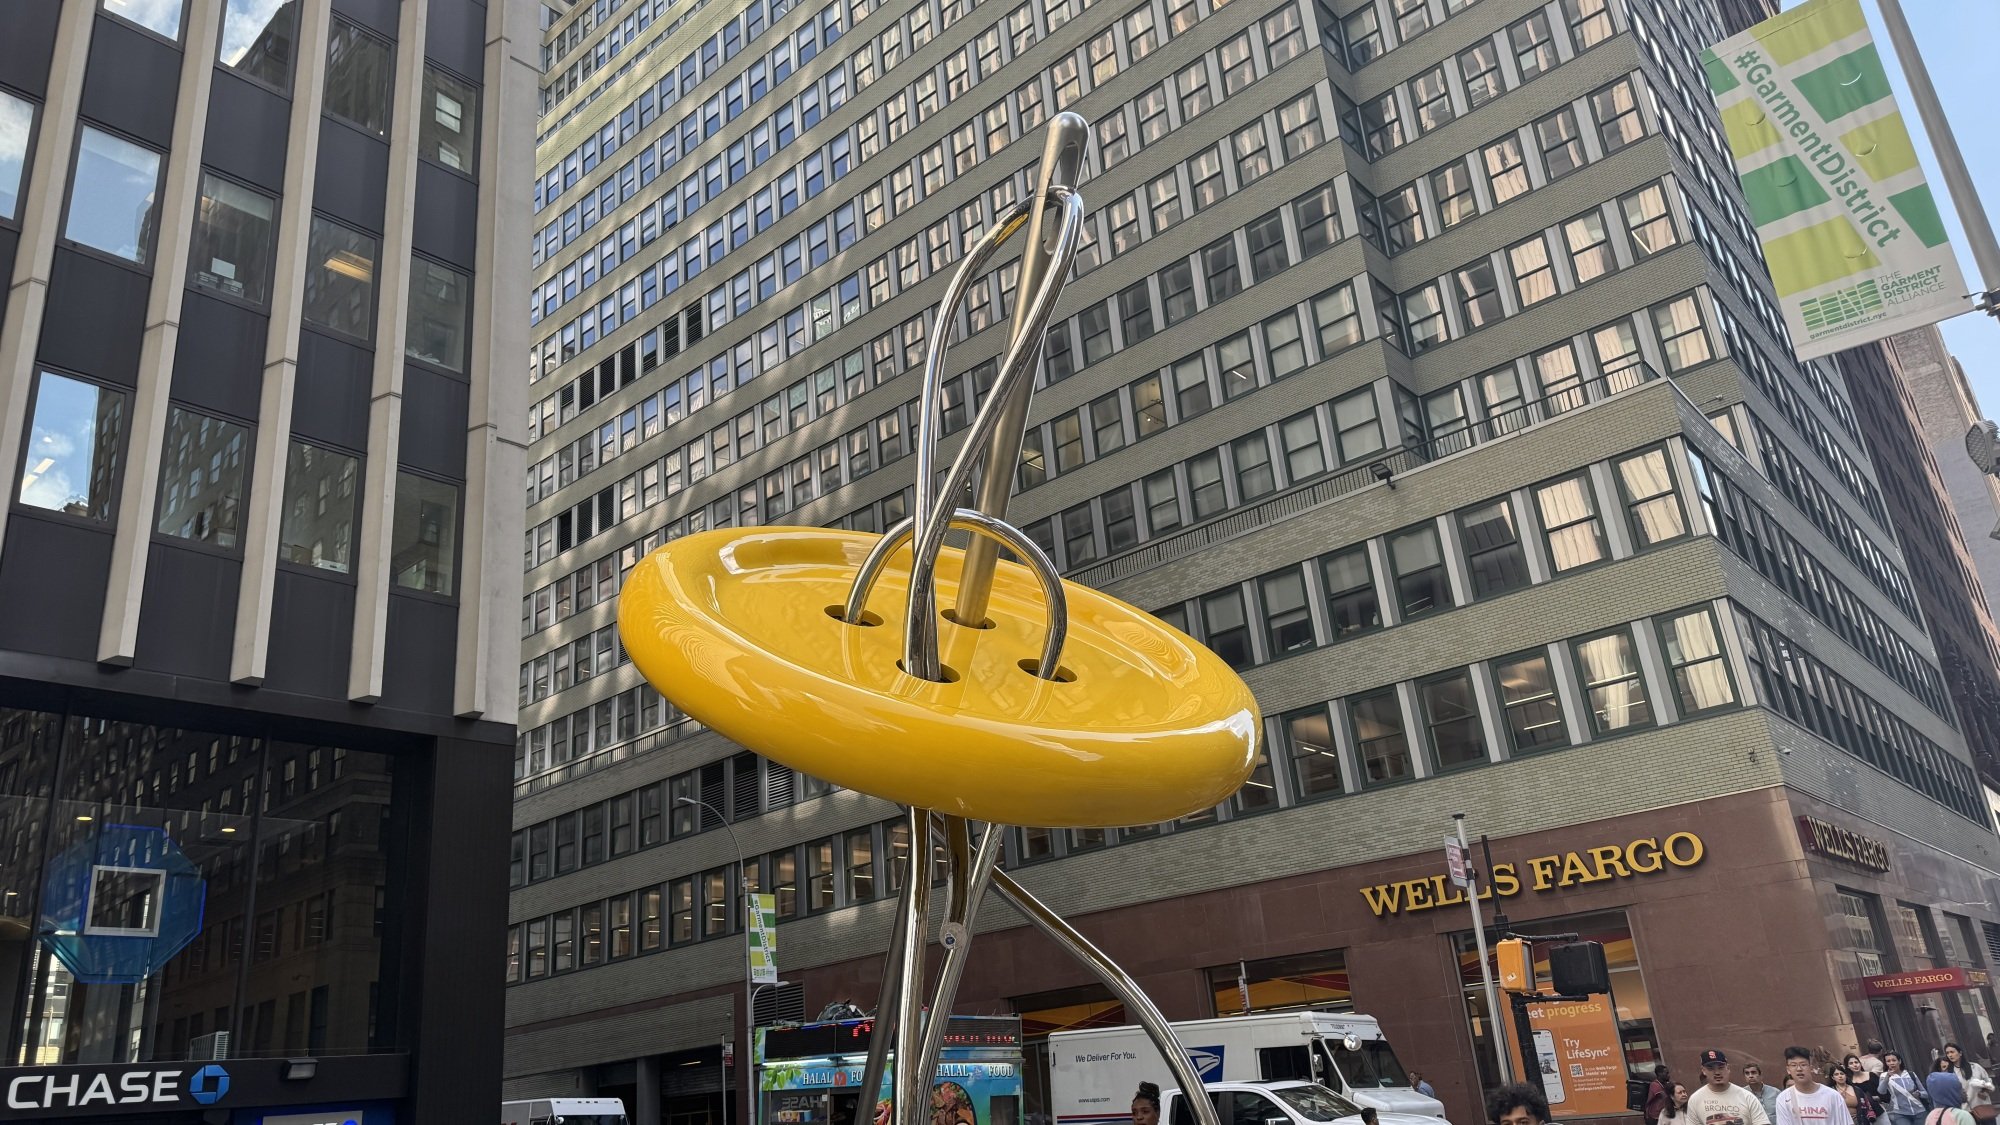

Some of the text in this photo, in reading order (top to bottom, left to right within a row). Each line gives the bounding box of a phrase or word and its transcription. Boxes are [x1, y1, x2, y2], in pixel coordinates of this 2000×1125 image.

[1733, 50, 1901, 248] #GarmentDistrict
[1879, 270, 1902, 284] THE
[1881, 265, 1942, 292] GARMENT
[1884, 275, 1939, 300] DISTRICT
[1887, 281, 1947, 307] ALLIANCE
[1809, 311, 1888, 340] garmentdistrict.nyc
[1806, 815, 1857, 862] WELLS
[1526, 831, 1704, 892] FARGO
[1873, 976, 1913, 989] WELLS
[1914, 973, 1953, 985] FARGO
[1546, 1003, 1602, 1020] progress
[1563, 1038, 1580, 1048] Try
[1075, 1051, 1137, 1063] We Deliver For You.
[803, 1070, 864, 1085] HALAL FO
[936, 1064, 1014, 1077] HALAL FOOD
[7, 1070, 184, 1109] CHASE
[1705, 1104, 1740, 1112] BRONCO
